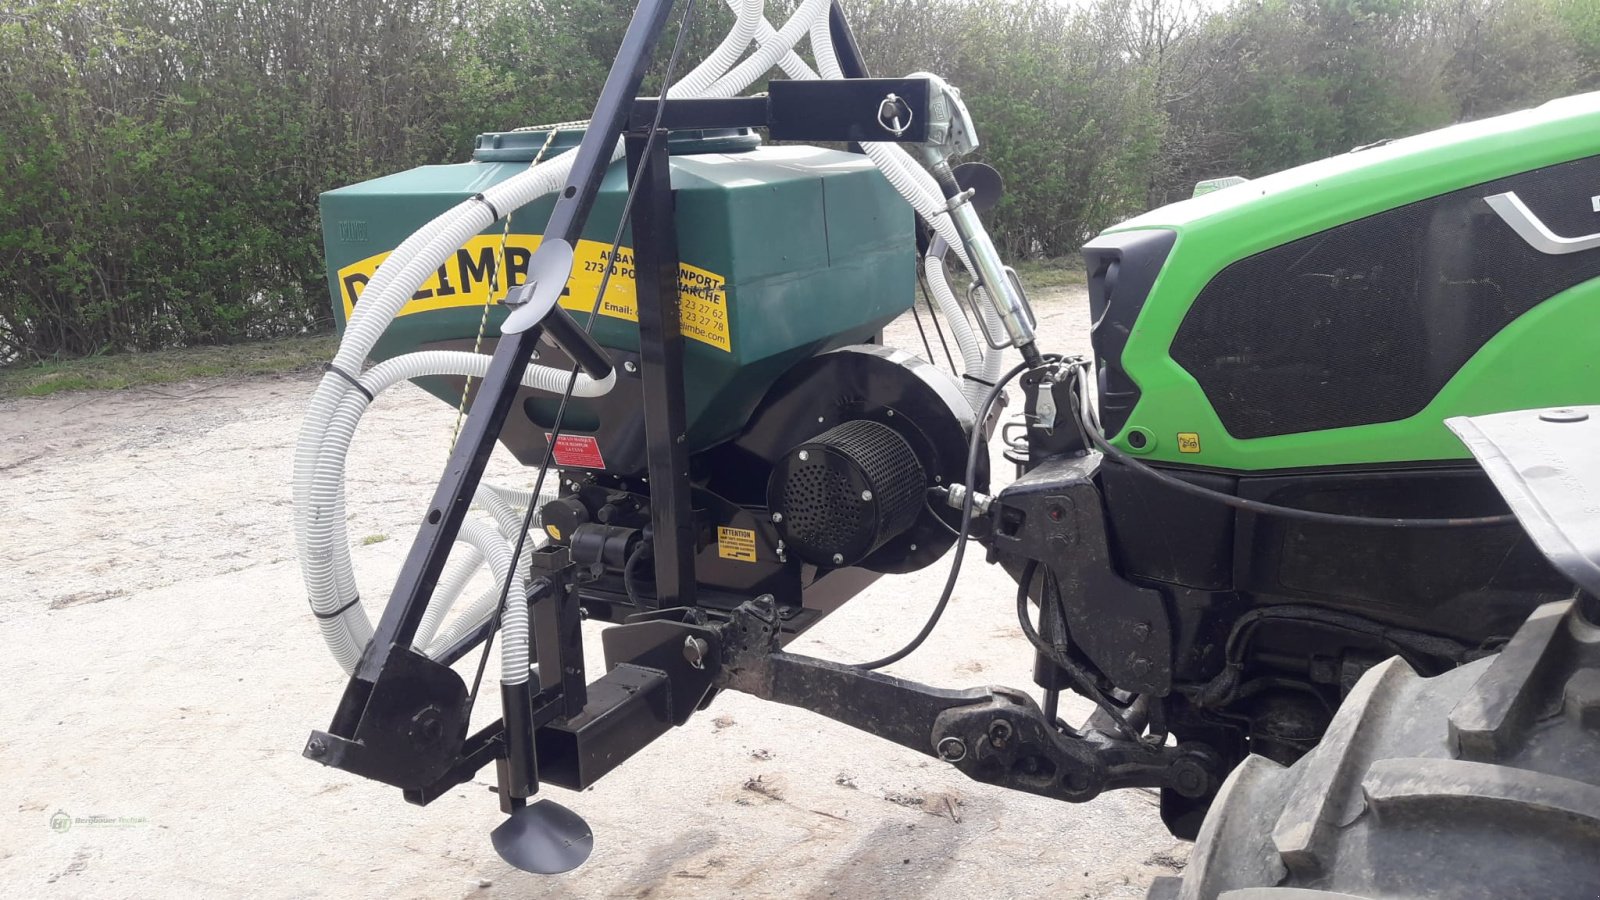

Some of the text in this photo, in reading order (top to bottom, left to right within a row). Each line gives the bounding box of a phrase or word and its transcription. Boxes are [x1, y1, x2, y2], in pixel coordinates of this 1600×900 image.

[584, 260, 618, 276] 2730
[604, 301, 633, 315] Email:
[685, 299, 696, 310] 23
[698, 303, 710, 314] 27
[712, 309, 724, 320] 62
[685, 311, 697, 322] 23
[699, 316, 711, 326] 27
[713, 320, 724, 332] 78
[722, 528, 751, 538] ATTENTION
